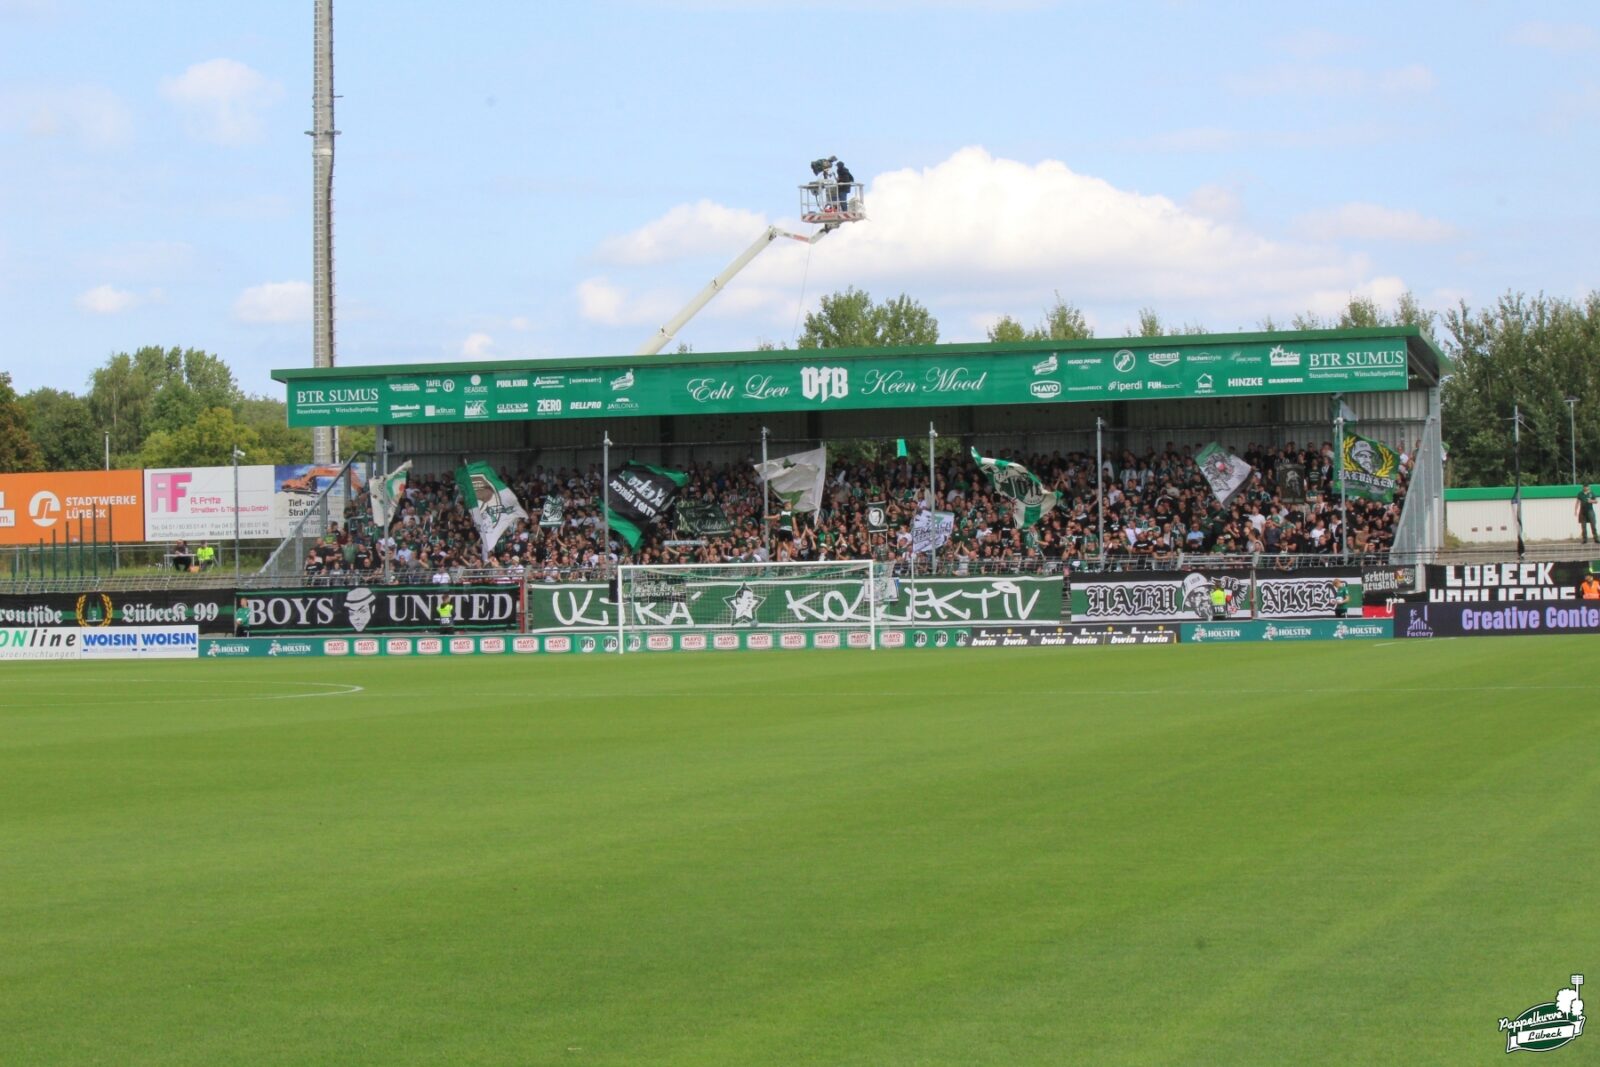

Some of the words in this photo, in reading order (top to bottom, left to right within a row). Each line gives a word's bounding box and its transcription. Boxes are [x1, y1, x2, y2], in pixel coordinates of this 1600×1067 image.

[1309, 353, 1342, 367] BTR
[1346, 351, 1404, 366] SUMUS
[426, 379, 441, 387] TAFEL
[860, 369, 917, 395] Keen
[922, 366, 987, 393] Mood
[1228, 377, 1263, 387] HINZKE
[686, 377, 734, 402] Echt
[1033, 384, 1058, 392] MAYO
[1117, 380, 1142, 392] iperdi
[296, 391, 325, 403] BTR
[329, 388, 379, 401] SUMUS
[66, 495, 137, 507] STADTWERKE
[288, 499, 305, 507] Tief-
[307, 499, 320, 507] un
[66, 508, 106, 519] LÜBECK
[194, 602, 219, 622] 99
[248, 598, 333, 625] BOYS
[1462, 606, 1540, 631] Creative
[1546, 606, 1600, 630] Conte
[1207, 629, 1241, 638] HOLSTEN
[1278, 628, 1312, 636] HOLSTEN
[1349, 626, 1384, 635] HOLSTEN
[1407, 630, 1433, 639] Factory
[83, 634, 137, 646] WOISIN
[141, 632, 197, 645] WOISIN
[971, 638, 996, 646] bwin
[1003, 637, 1028, 645] bwin
[1040, 637, 1066, 645] bwin
[1072, 636, 1097, 644] bwin
[1111, 635, 1136, 644] bwin
[1143, 635, 1168, 643] bwin
